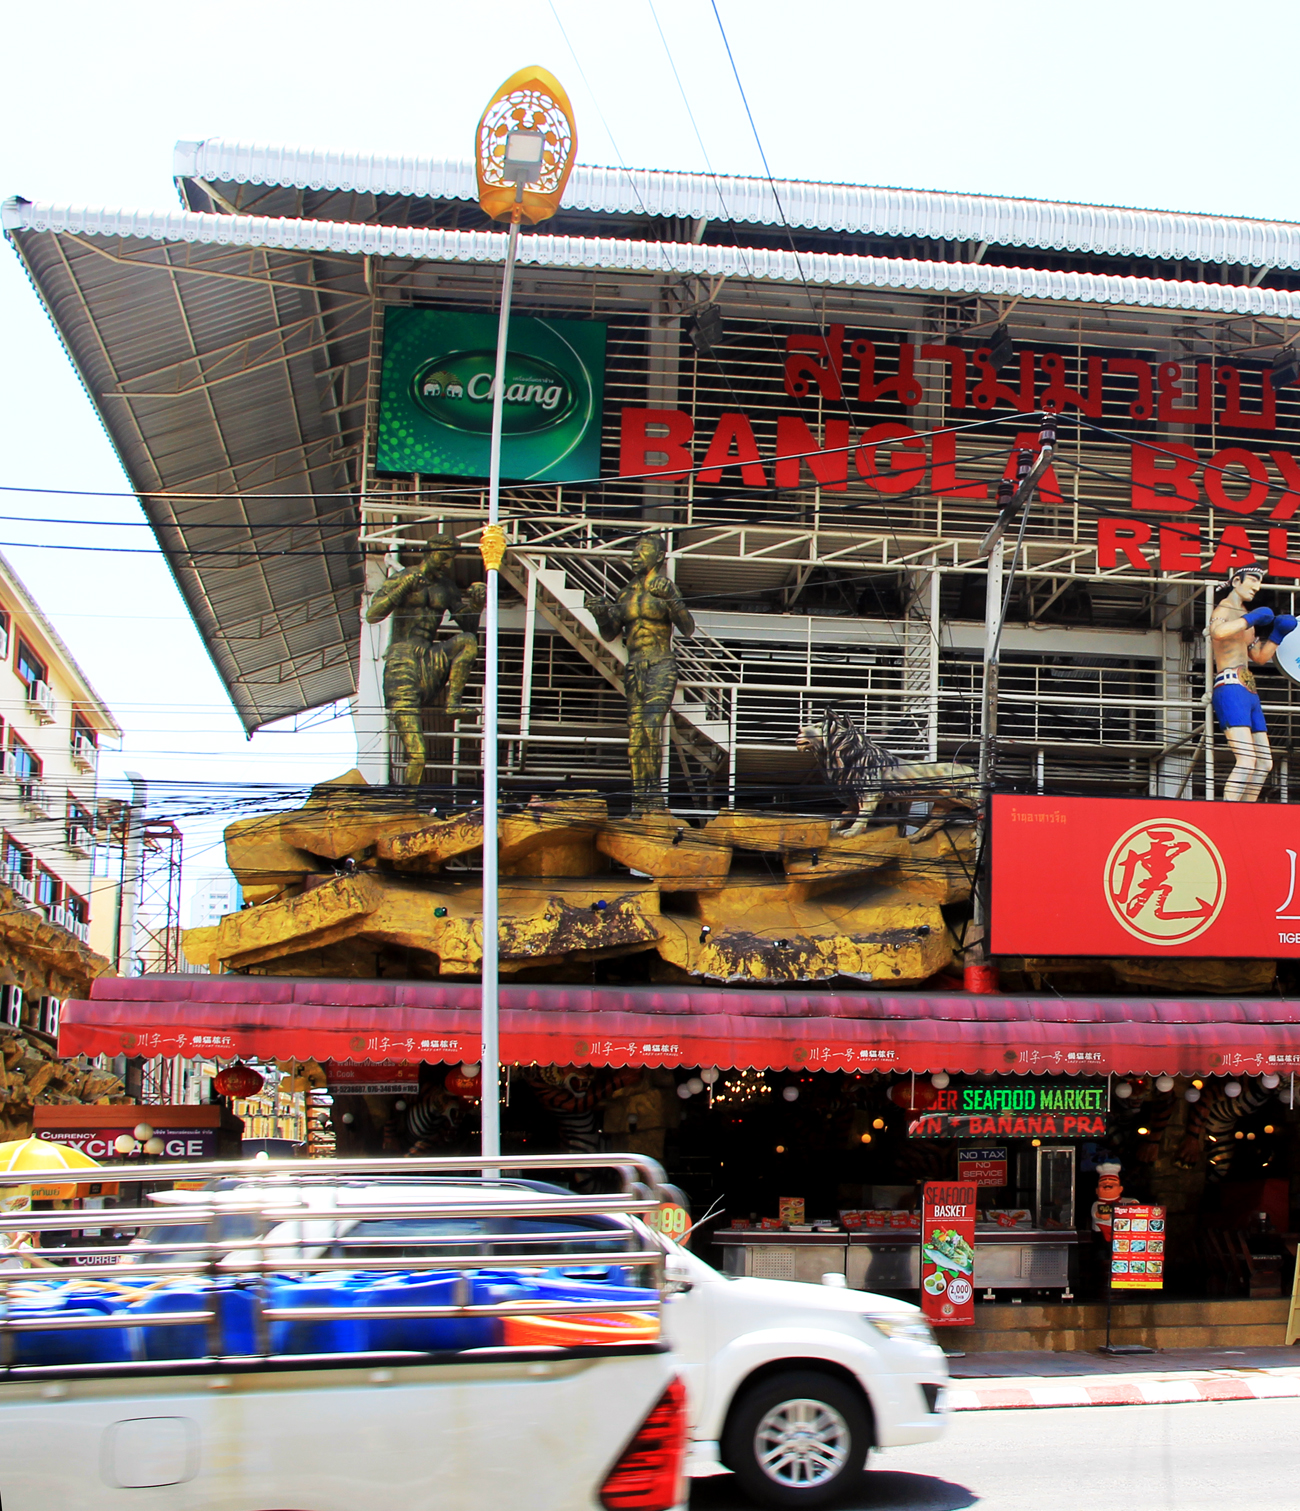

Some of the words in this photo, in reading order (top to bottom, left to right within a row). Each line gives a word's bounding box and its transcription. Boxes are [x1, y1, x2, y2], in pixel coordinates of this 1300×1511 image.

[619, 407, 1064, 503] BANGLA
[137, 1032, 187, 1048] 川字一号
[336, 1070, 355, 1078] Cook
[963, 1089, 1035, 1110] SEAFOOD
[1040, 1089, 1103, 1110] MARKET
[969, 1116, 1057, 1134] BANANA
[1063, 1116, 1106, 1134] PRA
[960, 1151, 978, 1159] NO
[983, 1150, 1005, 1159] TAX
[926, 1187, 974, 1205] SEAFOOD
[934, 1205, 967, 1217] BASKET
[950, 1284, 969, 1296] 2,000
